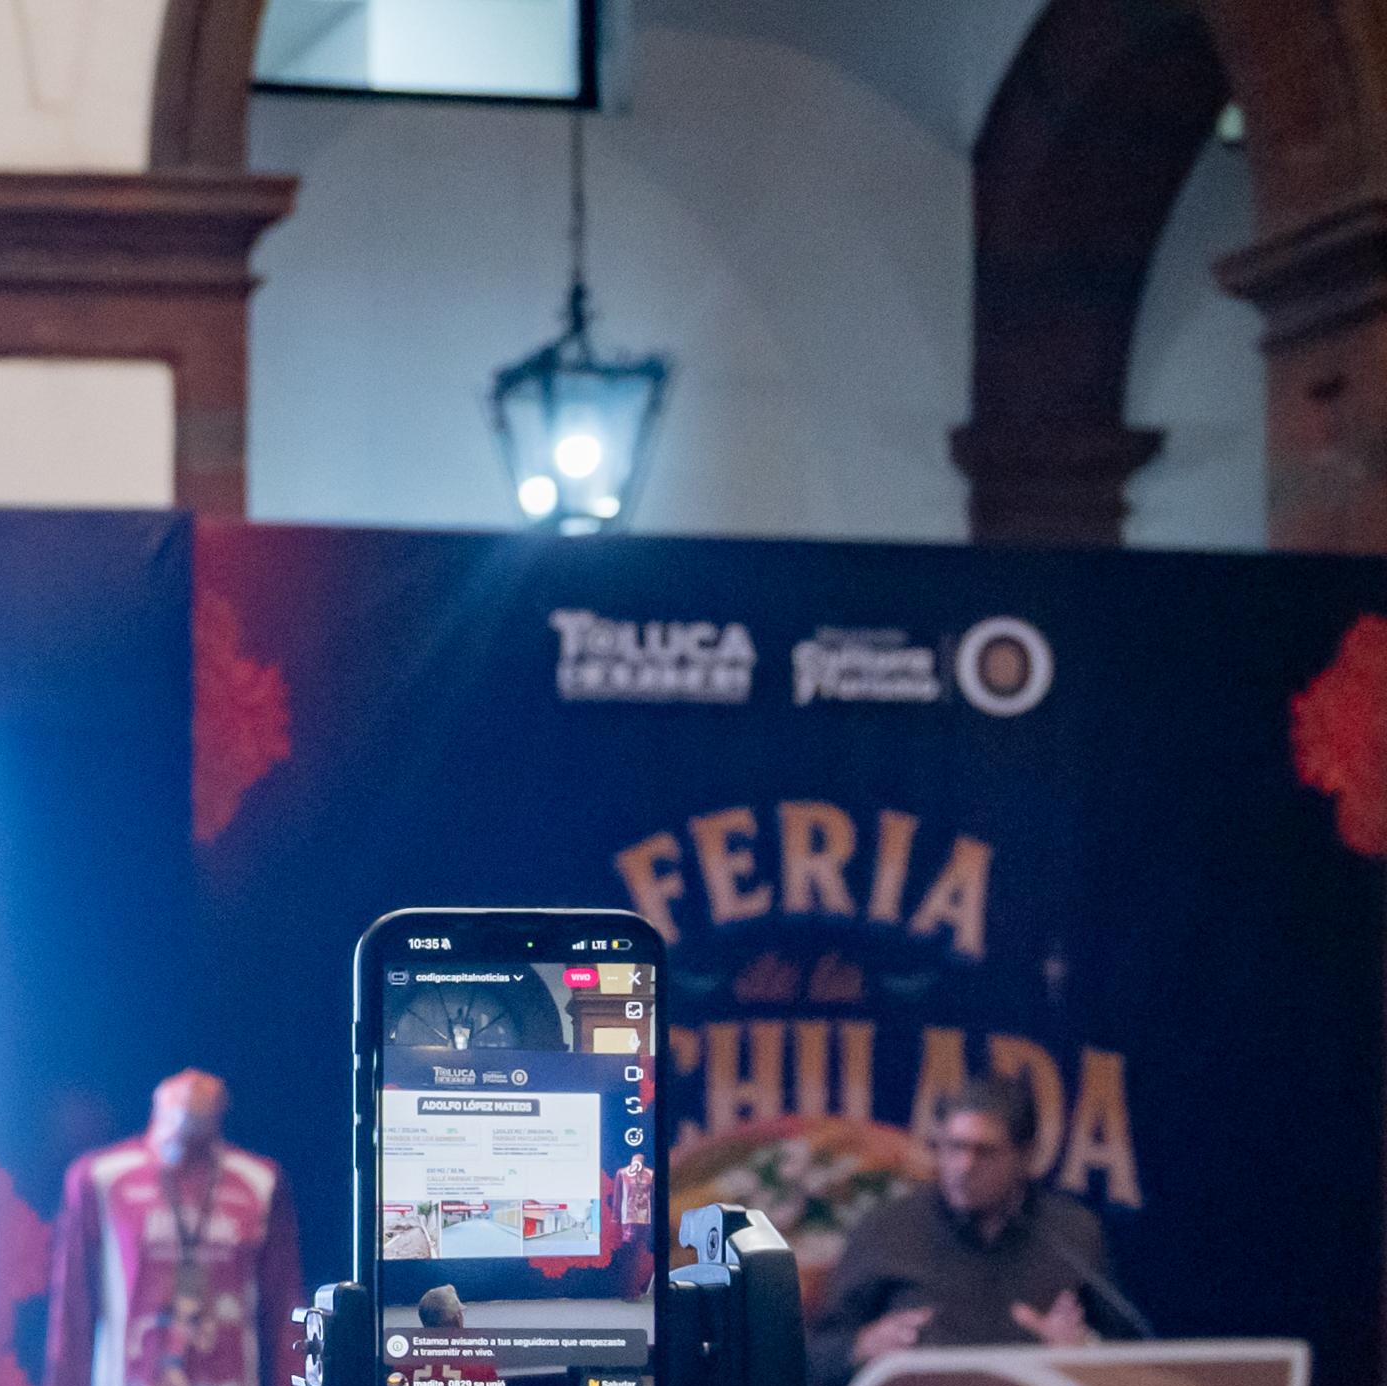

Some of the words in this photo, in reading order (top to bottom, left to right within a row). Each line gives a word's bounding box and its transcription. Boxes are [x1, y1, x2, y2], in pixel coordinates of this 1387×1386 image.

[614, 800, 993, 960] FERIA
[408, 938, 440, 950] 10:35
[592, 940, 607, 950] LTE
[415, 972, 510, 984] codigocapitalnoticias
[570, 973, 591, 982] VIVO
[422, 1100, 462, 1111] ADOLFO
[463, 1099, 493, 1112] LÓPEZ
[494, 1101, 533, 1113] MATEOS
[412, 1336, 449, 1346] Estamos
[450, 1337, 489, 1346] avisando
[497, 1338, 512, 1346] tus
[513, 1337, 560, 1348] seguidores
[561, 1339, 578, 1348] que
[578, 1338, 626, 1348] empezaste
[420, 1348, 461, 1356] transmitir
[475, 1348, 495, 1357] vivo.
